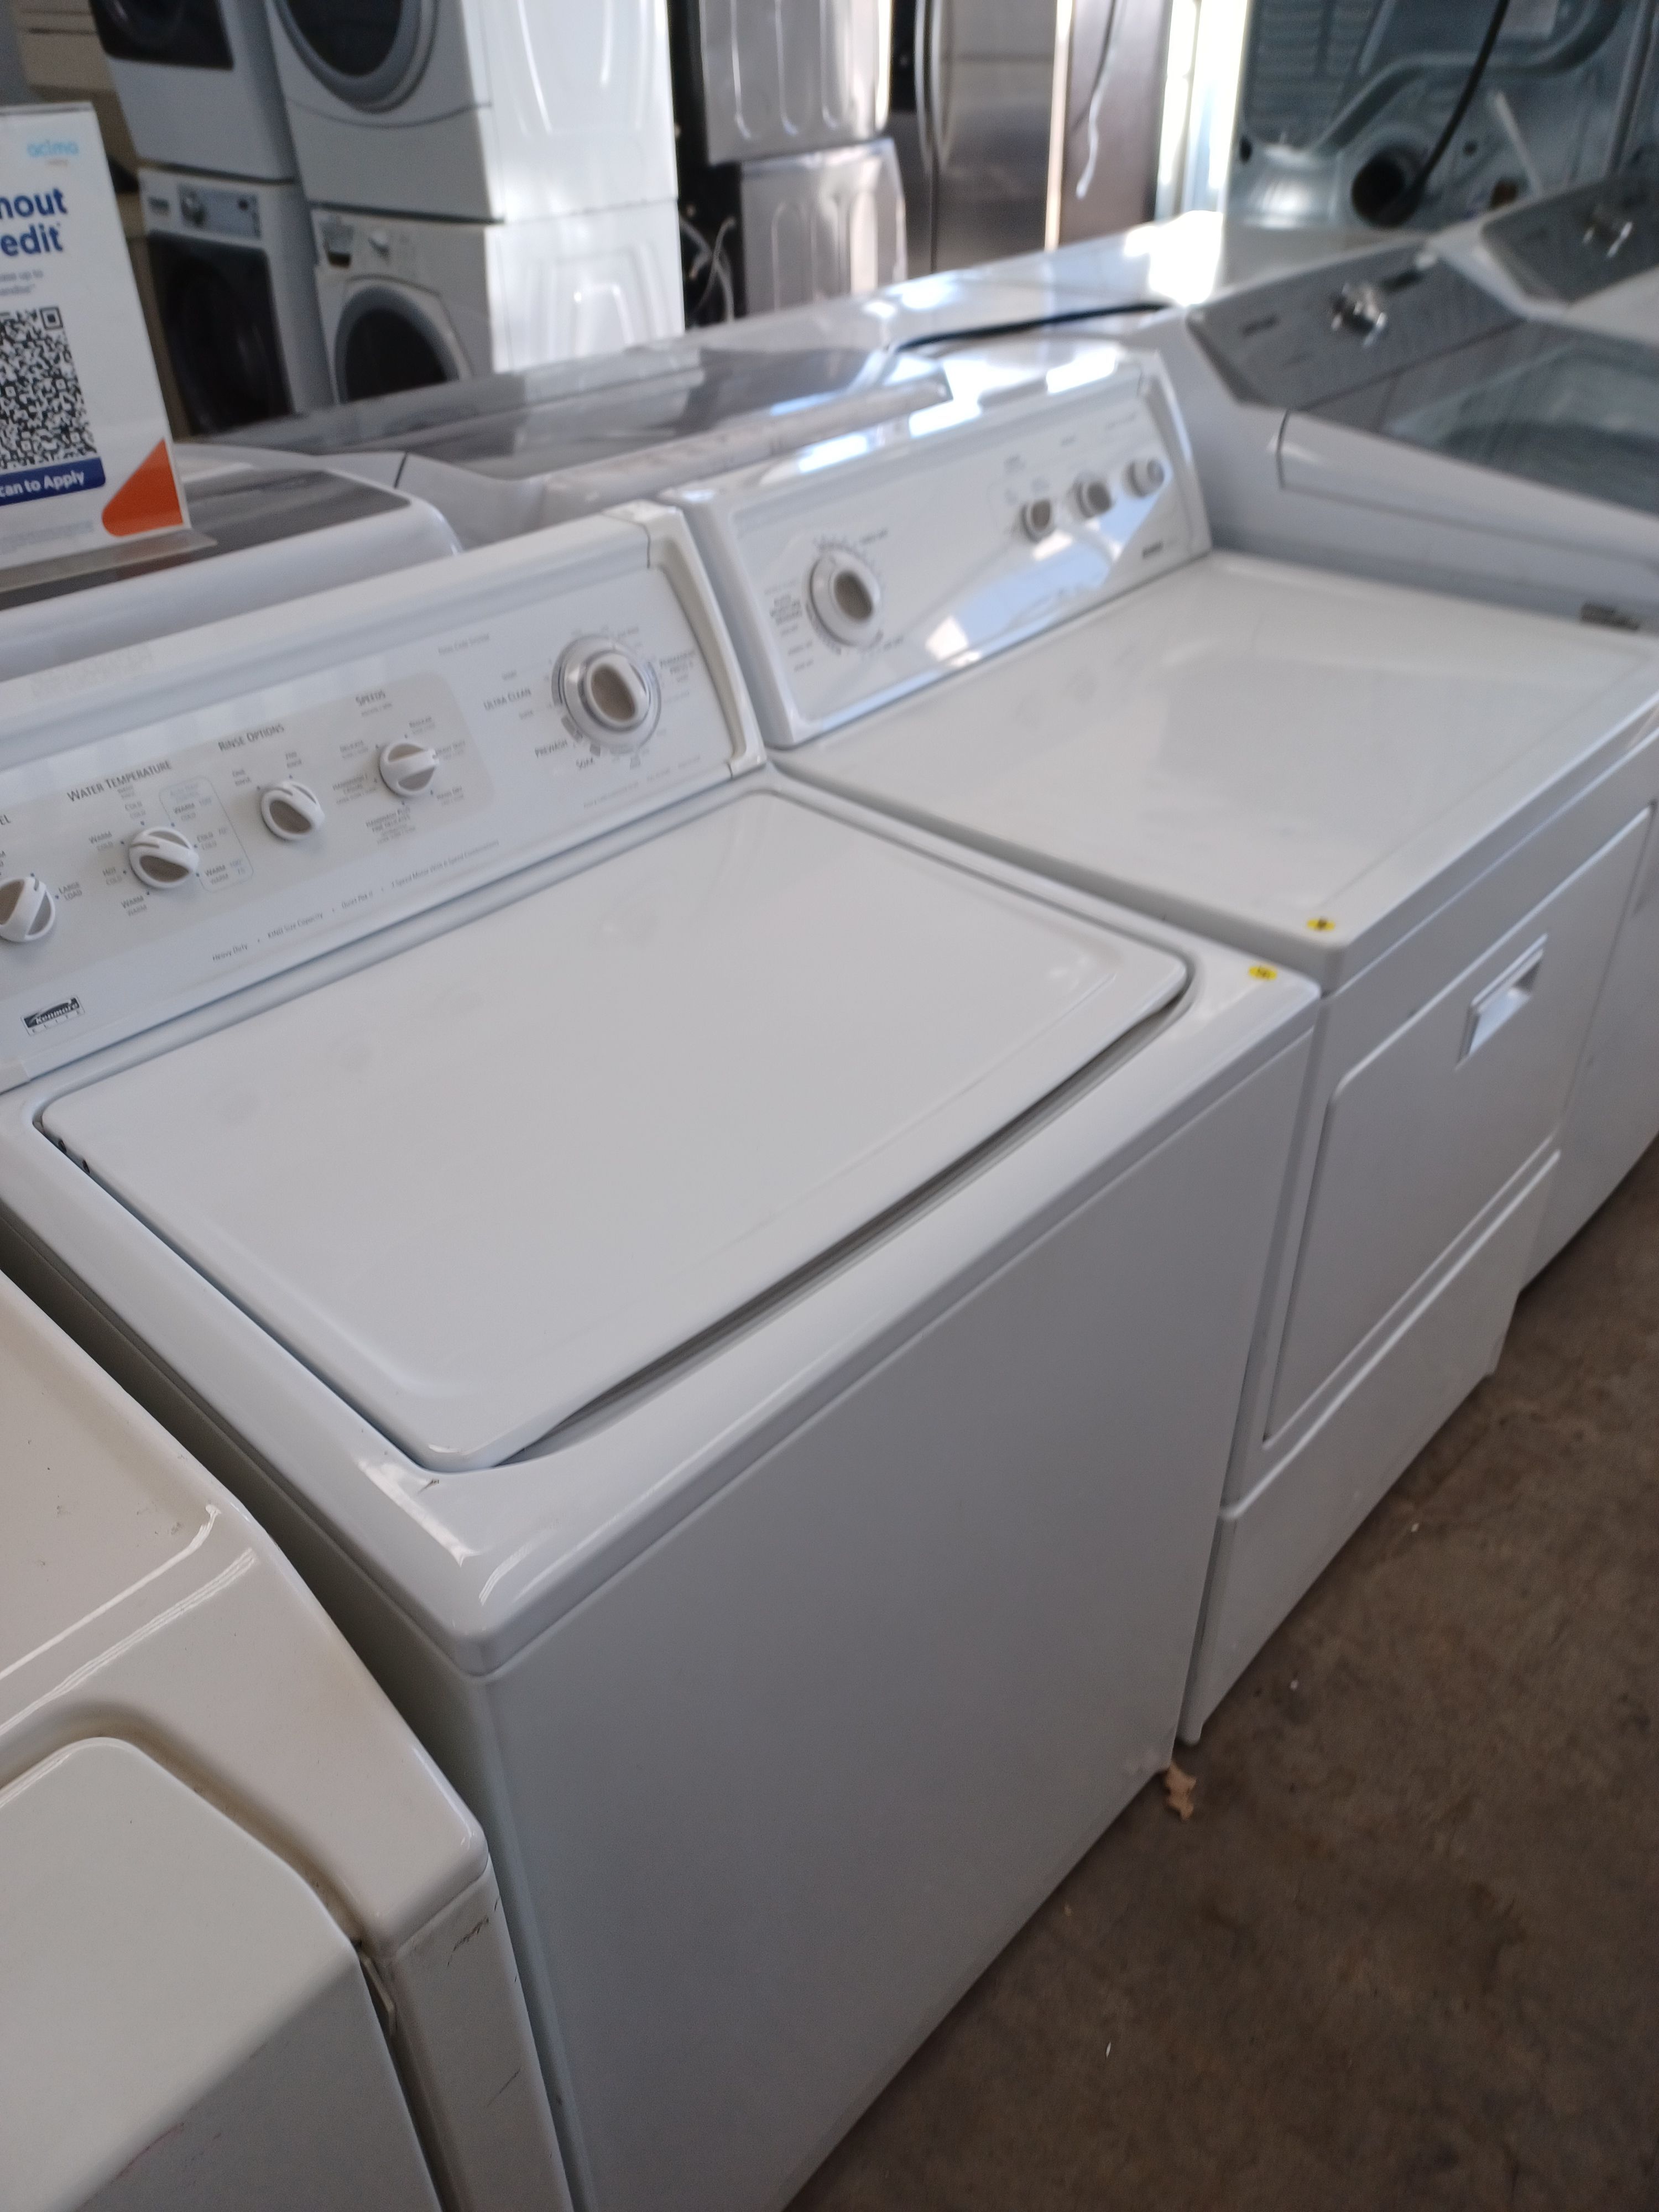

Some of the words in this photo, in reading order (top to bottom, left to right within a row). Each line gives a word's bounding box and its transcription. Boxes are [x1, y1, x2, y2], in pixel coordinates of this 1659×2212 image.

[24, 479, 41, 493] to
[44, 470, 85, 491] Apply
[508, 688, 531, 702] CLEAN
[246, 723, 284, 742] OPTIONS
[67, 782, 105, 801] WATER
[105, 760, 171, 789] TEMPERATURE
[212, 950, 232, 961] Heavy
[233, 943, 248, 954] Duty
